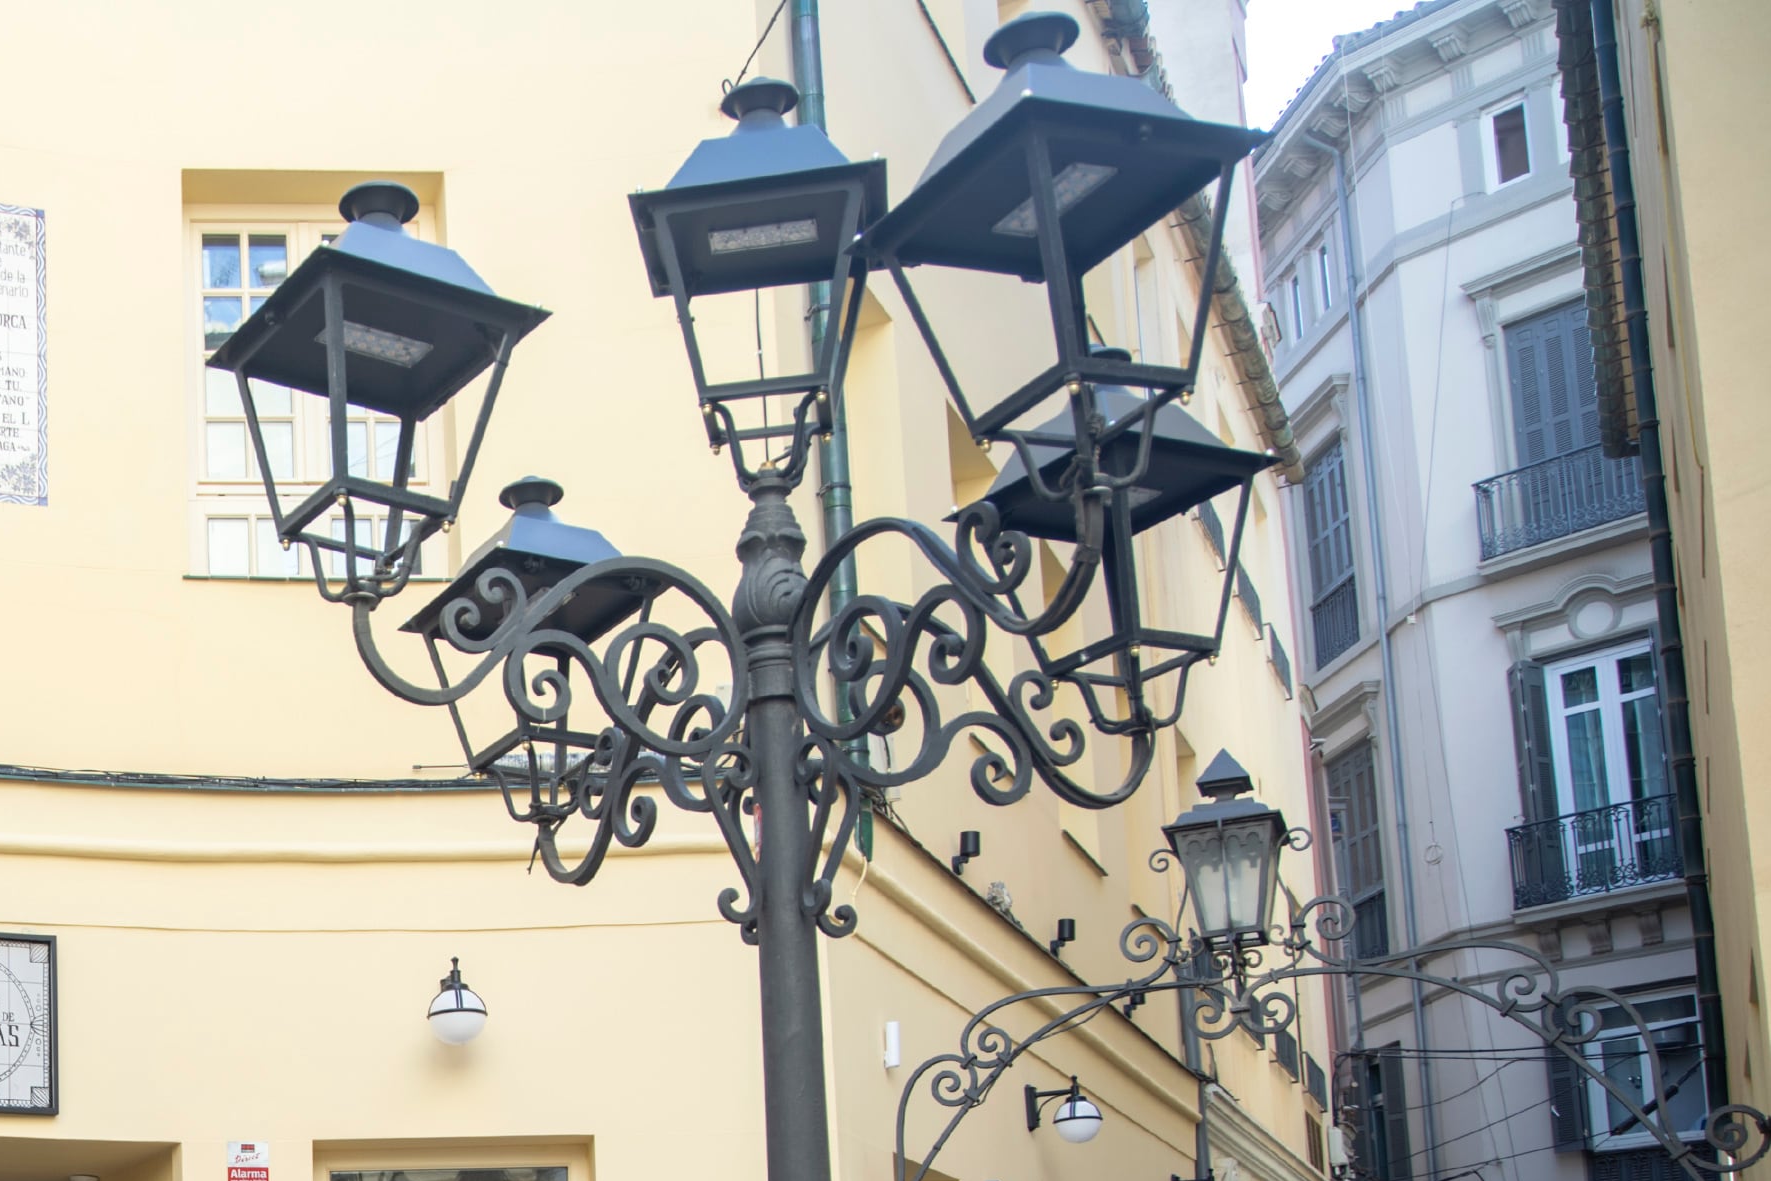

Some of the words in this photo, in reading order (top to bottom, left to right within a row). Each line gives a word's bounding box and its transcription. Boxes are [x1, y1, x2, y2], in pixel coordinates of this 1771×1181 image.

[1, 268, 13, 281] de
[17, 270, 25, 283] la
[2, 413, 16, 424] EL
[21, 412, 30, 425] L
[2, 1012, 15, 1022] DE
[231, 1169, 267, 1178] Alarma
